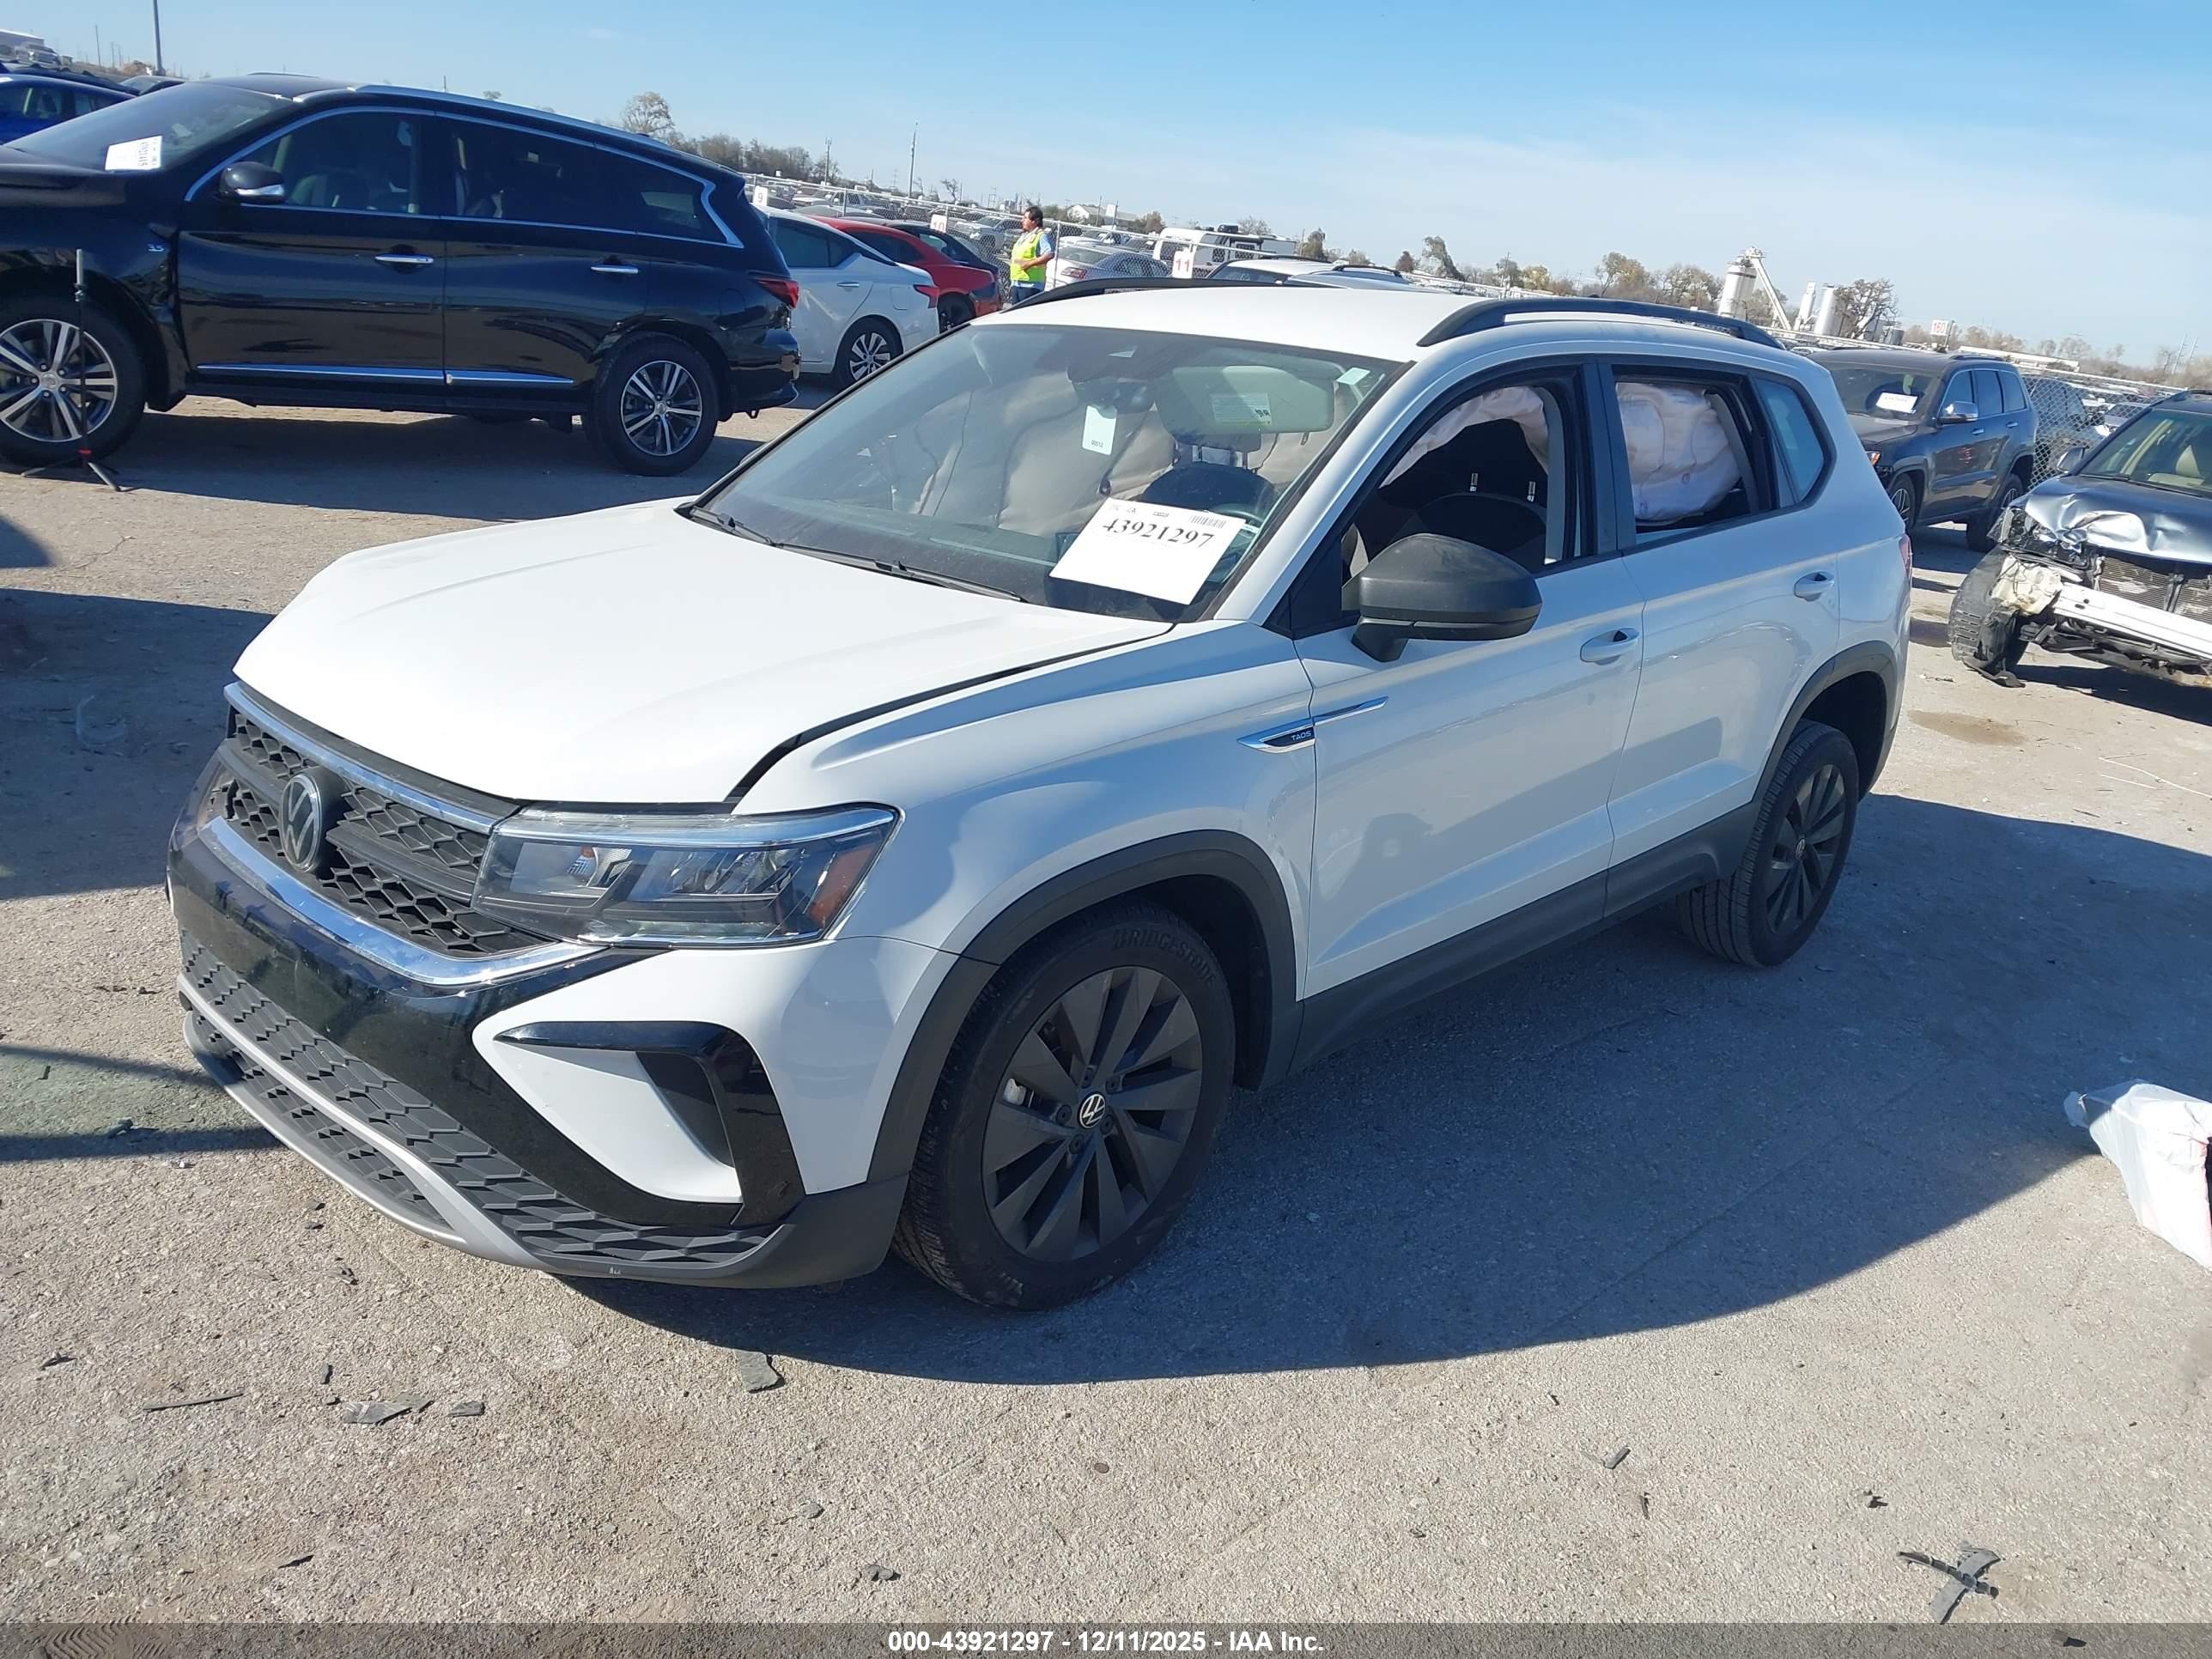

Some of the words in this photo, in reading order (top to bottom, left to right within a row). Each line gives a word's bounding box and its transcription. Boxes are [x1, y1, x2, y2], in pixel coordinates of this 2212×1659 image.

[757, 192, 763, 204] 9
[1176, 258, 1190, 272] 11
[1103, 517, 1215, 548] 43921297
[1291, 730, 1312, 742] TAOS
